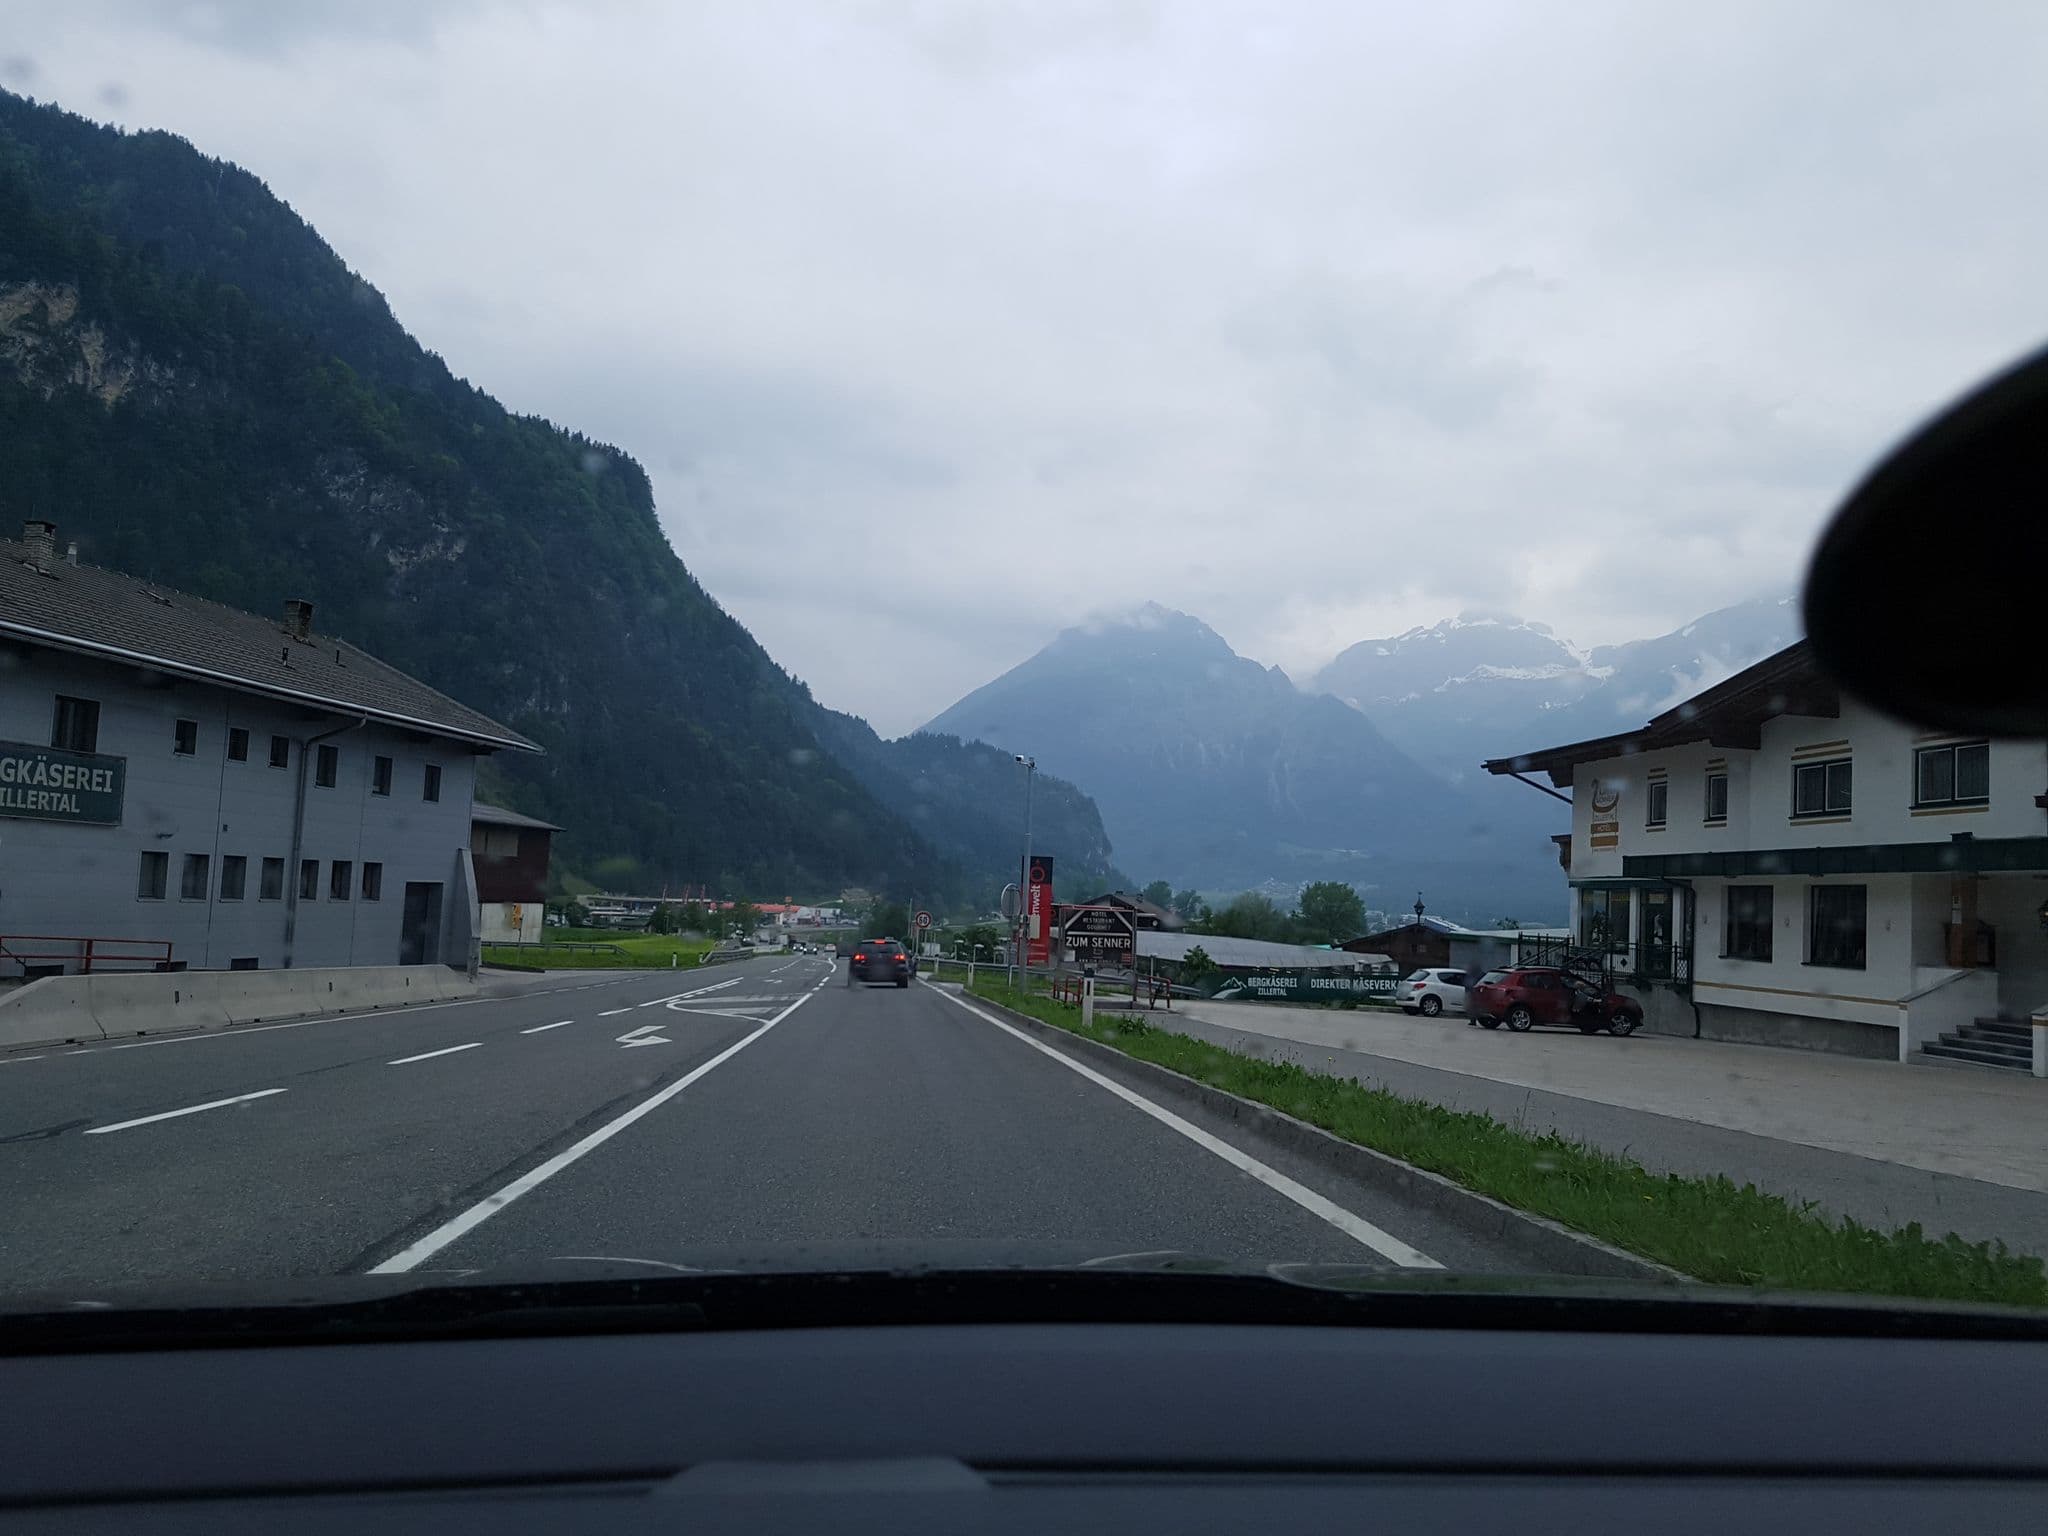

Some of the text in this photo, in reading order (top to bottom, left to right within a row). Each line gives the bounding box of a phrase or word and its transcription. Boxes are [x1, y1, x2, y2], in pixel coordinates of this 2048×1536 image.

[0, 755, 113, 792] GKÄSEREI
[1065, 936, 1131, 949] ZUM SENNER
[1247, 976, 1298, 988] BERGKÄSEREI
[1310, 977, 1401, 990] DIREKTER KÄSEVERK
[1257, 987, 1288, 996] ZILLERTAL
